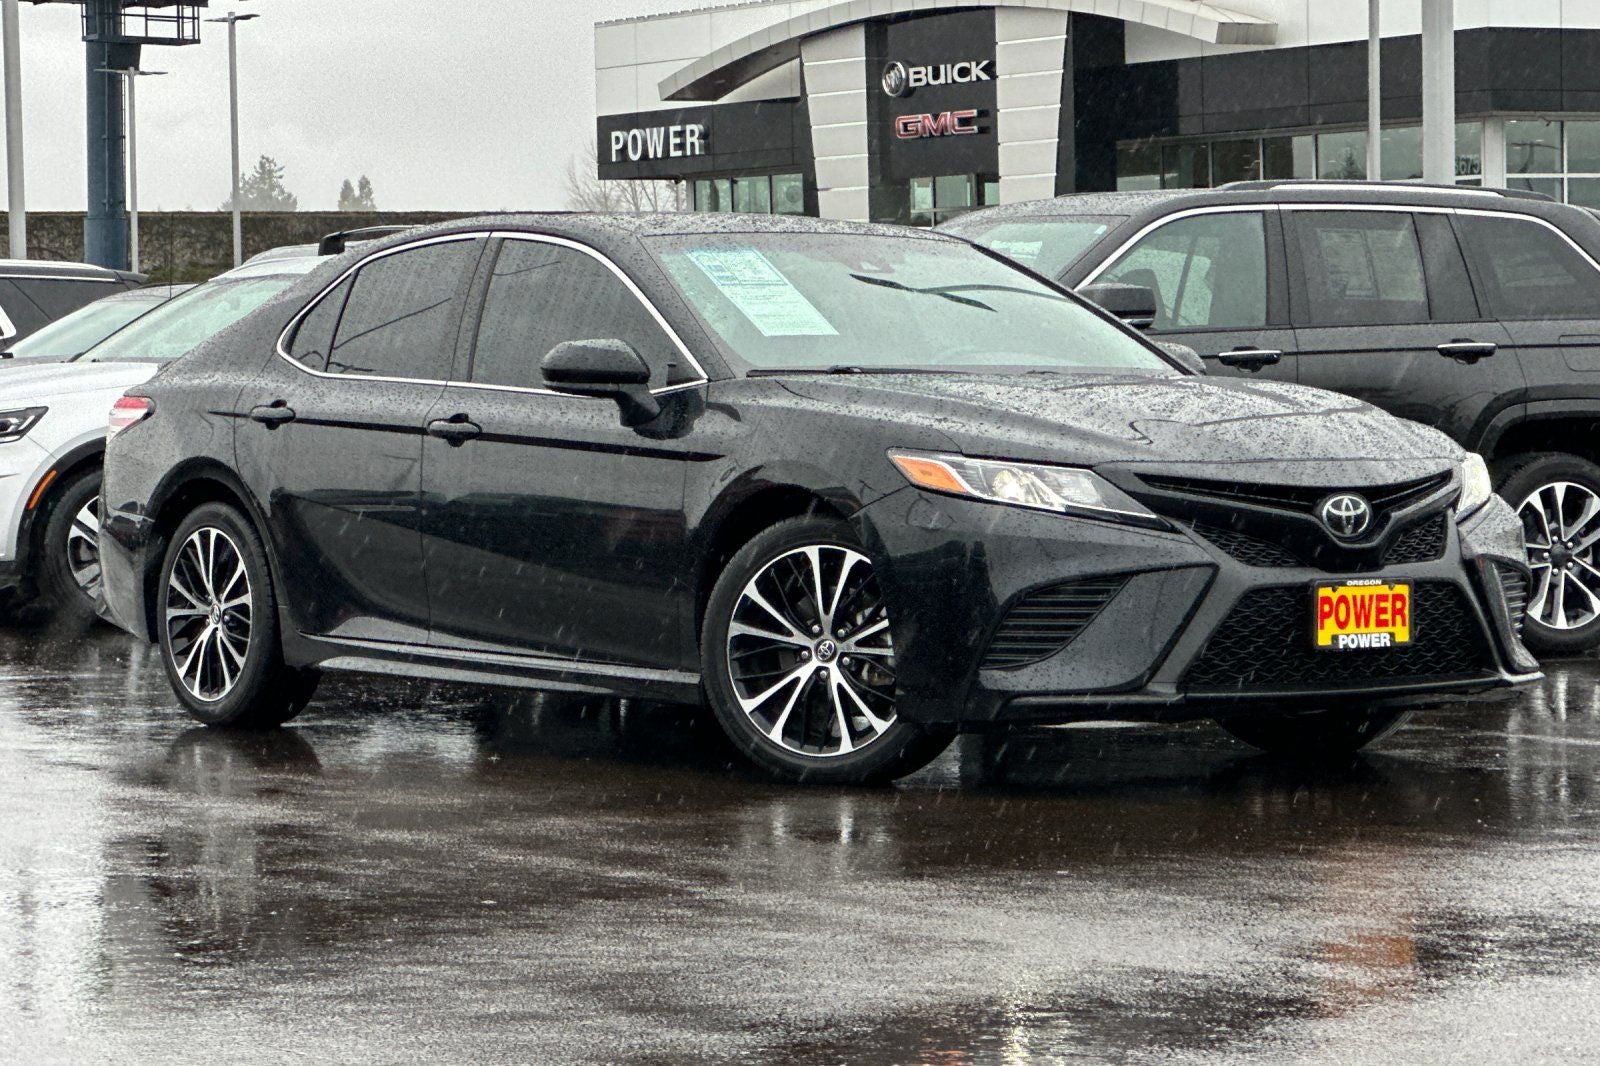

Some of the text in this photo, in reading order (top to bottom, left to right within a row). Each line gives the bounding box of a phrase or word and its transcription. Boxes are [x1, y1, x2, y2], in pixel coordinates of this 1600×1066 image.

[908, 60, 991, 87] BUICK
[895, 109, 979, 139] GMC
[610, 124, 704, 162] POWER
[1319, 593, 1407, 630] POWER
[1338, 633, 1391, 648] POWER
